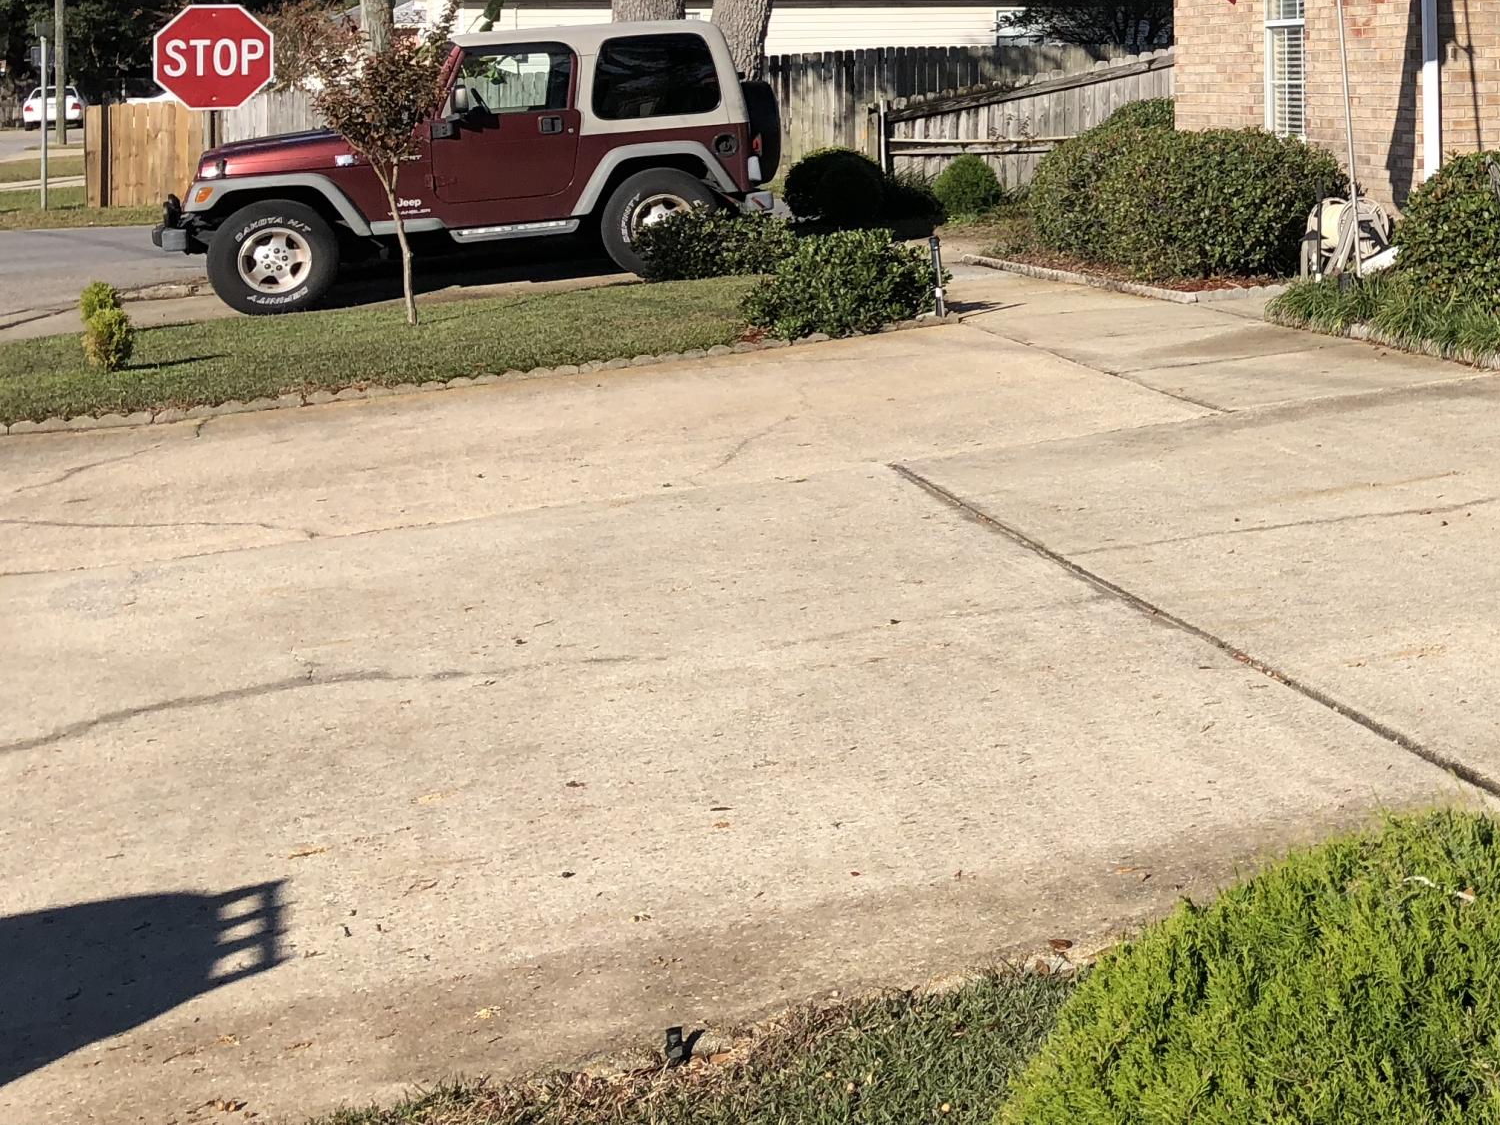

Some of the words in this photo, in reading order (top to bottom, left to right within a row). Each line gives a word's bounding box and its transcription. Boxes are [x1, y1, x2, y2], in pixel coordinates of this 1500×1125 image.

[163, 38, 265, 77] STOP
[396, 197, 422, 208] Jeep
[234, 216, 283, 243] DAKOTA
